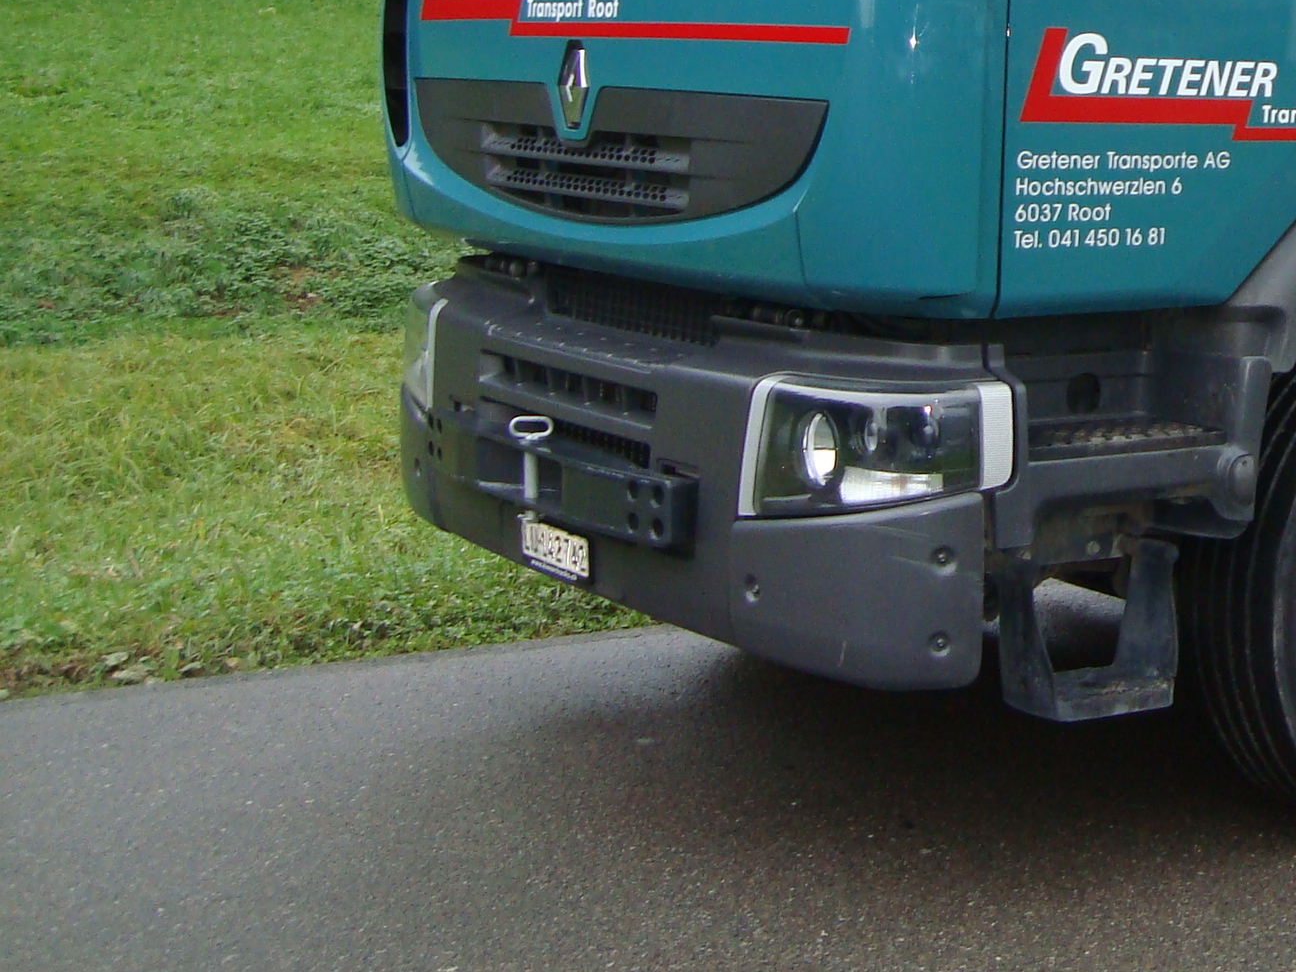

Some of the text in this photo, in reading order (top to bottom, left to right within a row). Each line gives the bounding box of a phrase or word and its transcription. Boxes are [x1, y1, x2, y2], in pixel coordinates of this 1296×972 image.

[1058, 32, 1278, 98] GRETENER
[1016, 150, 1231, 173] Gretener Transporte AG
[1171, 177, 1182, 195] 6
[1014, 203, 1112, 223] 6037 Root
[1013, 227, 1165, 249] Tel. 041 450 16 81
